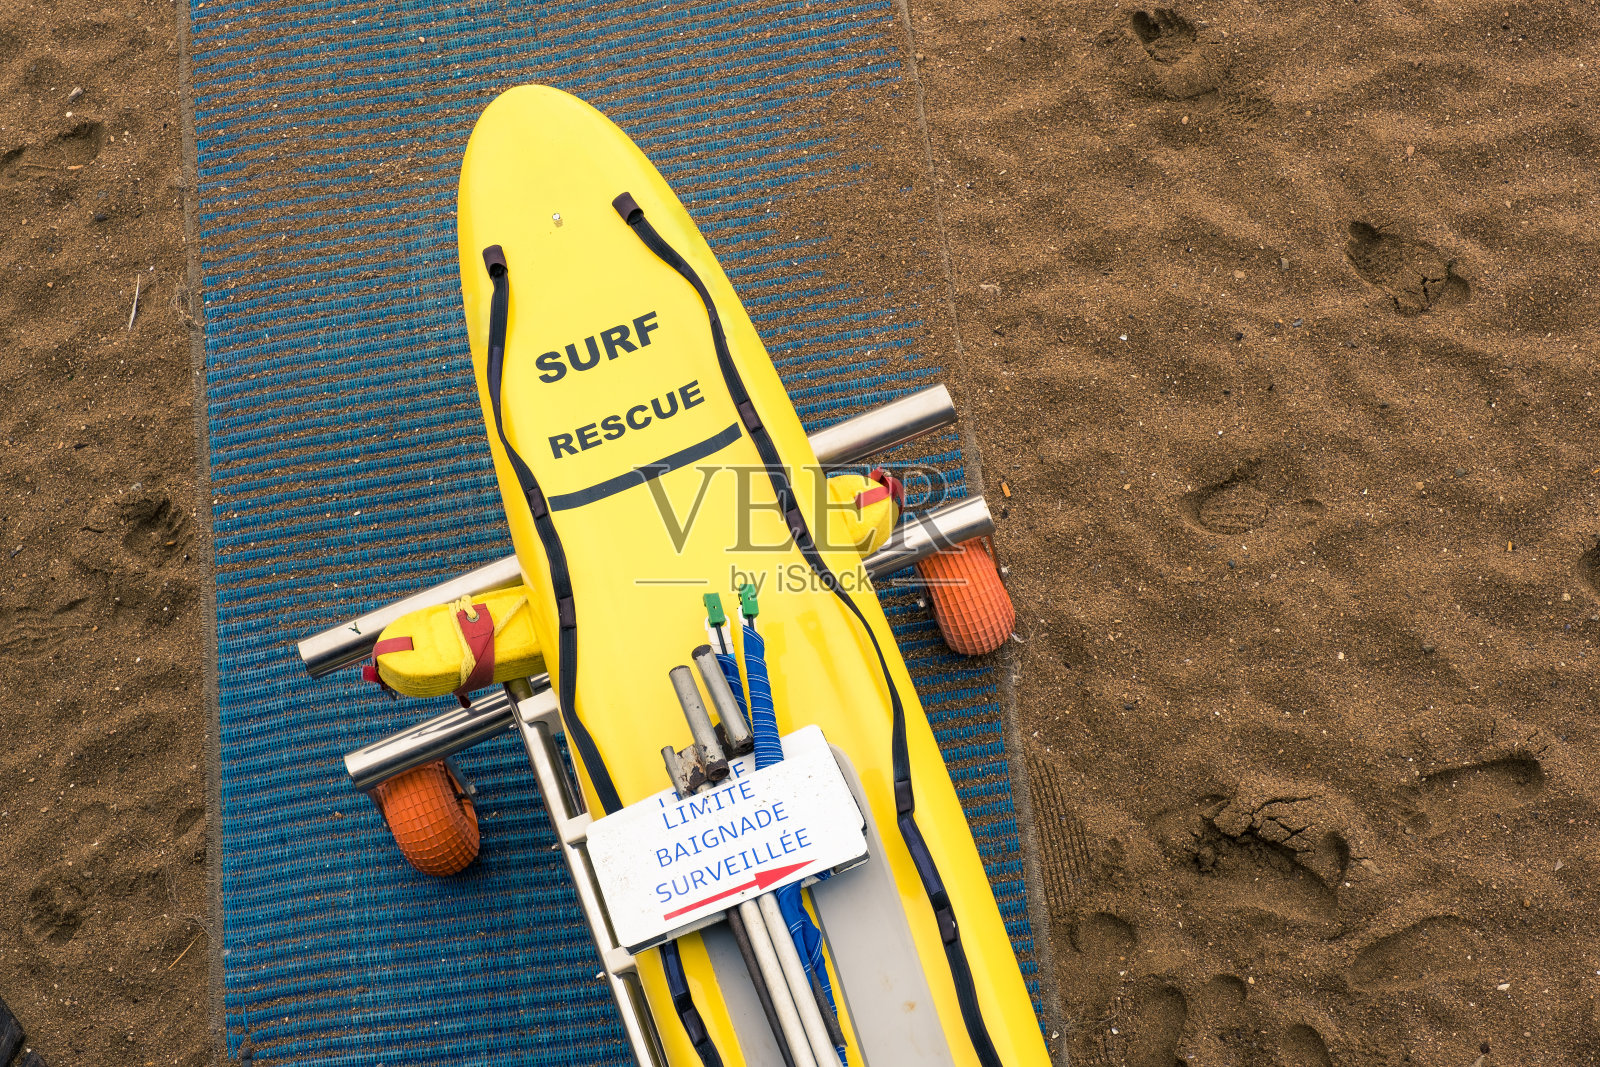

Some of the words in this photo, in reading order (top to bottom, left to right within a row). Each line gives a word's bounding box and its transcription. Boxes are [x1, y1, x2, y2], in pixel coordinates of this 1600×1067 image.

[535, 311, 660, 383] SURF
[548, 380, 706, 459] RESCUE
[656, 801, 789, 868] BAIGNADE
[662, 780, 755, 830] LIMITE
[656, 827, 812, 903] SURVEILLÉE
